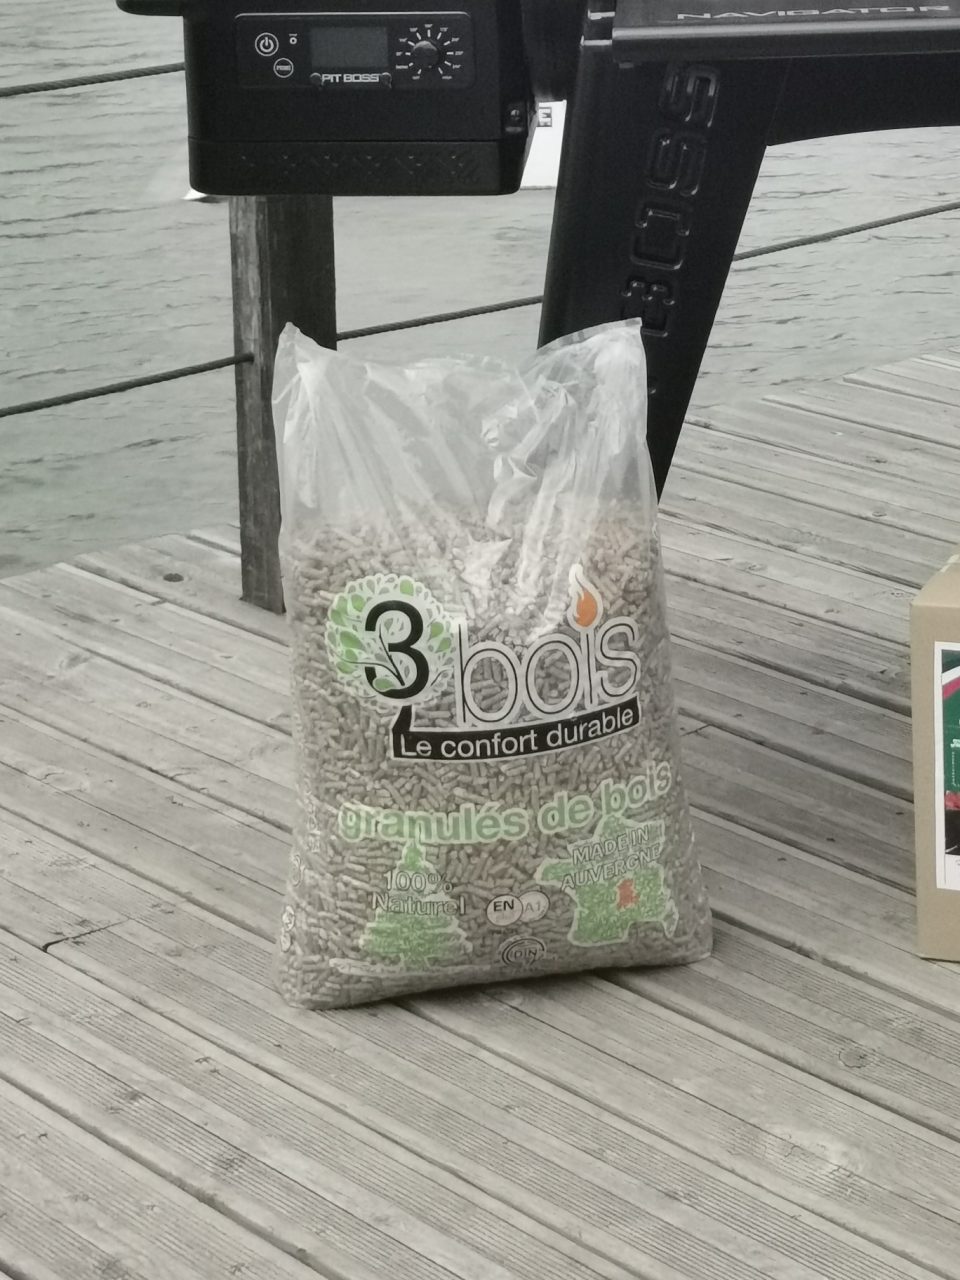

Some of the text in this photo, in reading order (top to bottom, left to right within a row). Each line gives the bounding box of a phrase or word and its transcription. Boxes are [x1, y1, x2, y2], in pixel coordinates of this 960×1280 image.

[677, 5, 950, 20] NAVIGATOR
[322, 73, 380, 83] PIT BOSS
[456, 616, 642, 726] bois
[400, 707, 634, 758] Le confort durable
[338, 802, 531, 843] granulés
[538, 791, 595, 834] de
[600, 759, 672, 820] bois
[572, 825, 651, 866] MADE IN
[383, 870, 455, 893] 100%
[561, 842, 663, 892] AUVERGNE
[369, 890, 467, 916] Naturel
[493, 898, 515, 912] EN
